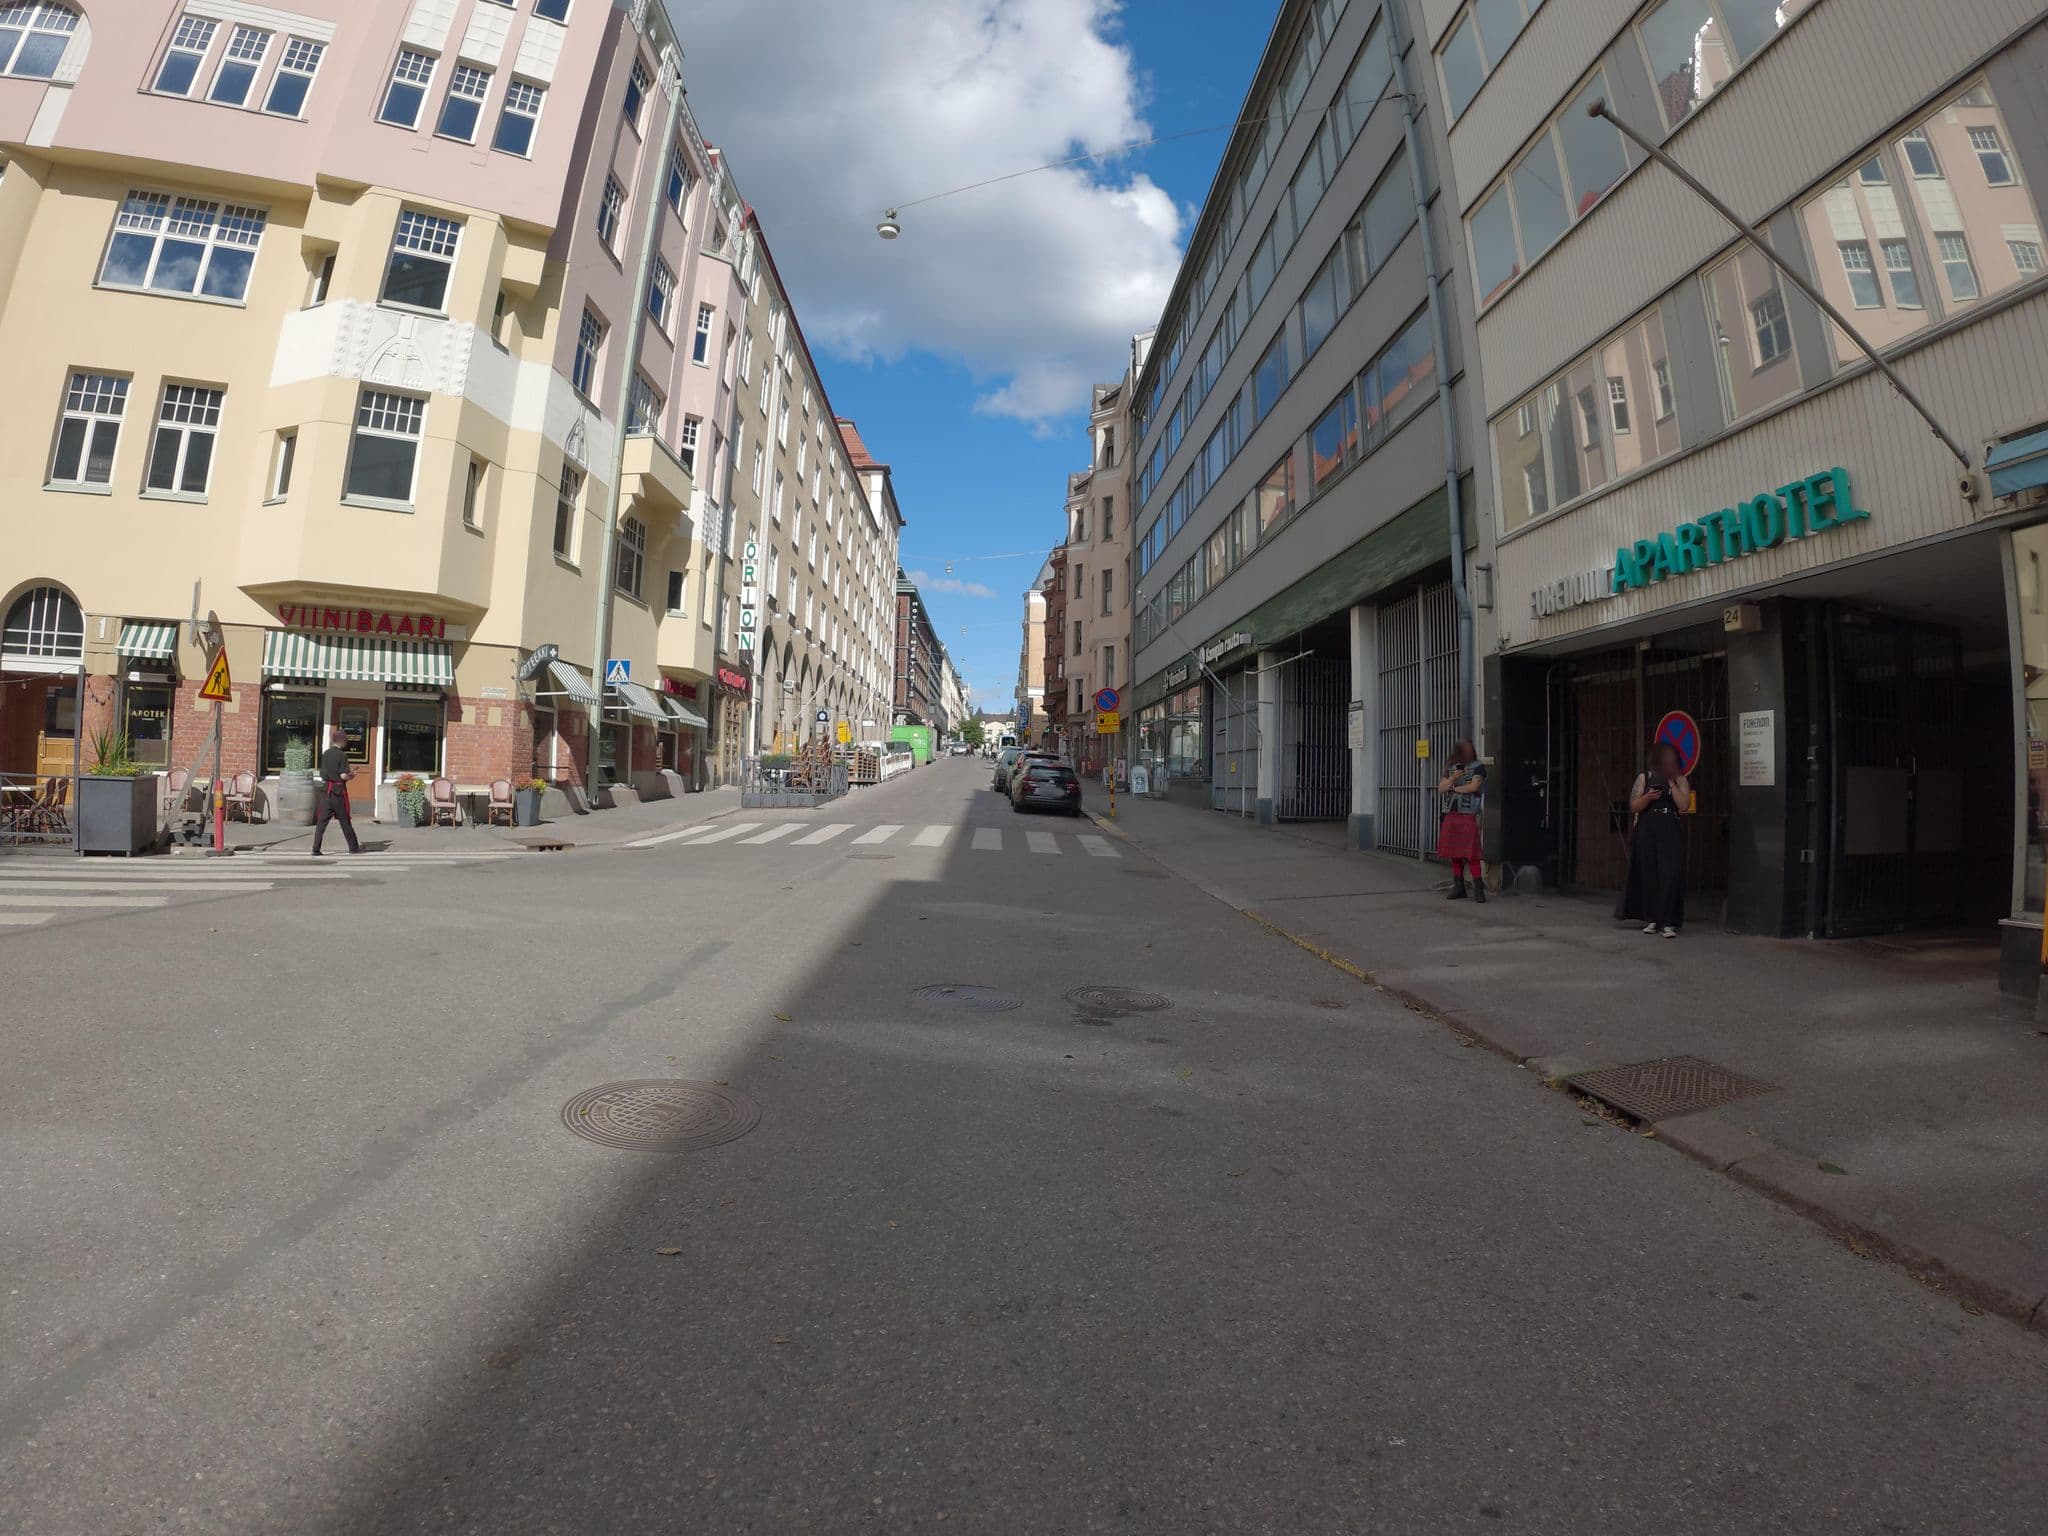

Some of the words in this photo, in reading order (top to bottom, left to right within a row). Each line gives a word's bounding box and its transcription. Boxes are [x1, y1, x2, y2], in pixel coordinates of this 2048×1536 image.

[1612, 466, 1871, 594] APARTHOTEL
[740, 543, 756, 650] ORION
[278, 603, 447, 639] VIINIBAARI
[911, 601, 919, 635] HOTEL
[1725, 610, 1740, 625] 24
[131, 708, 167, 719] APOTEK
